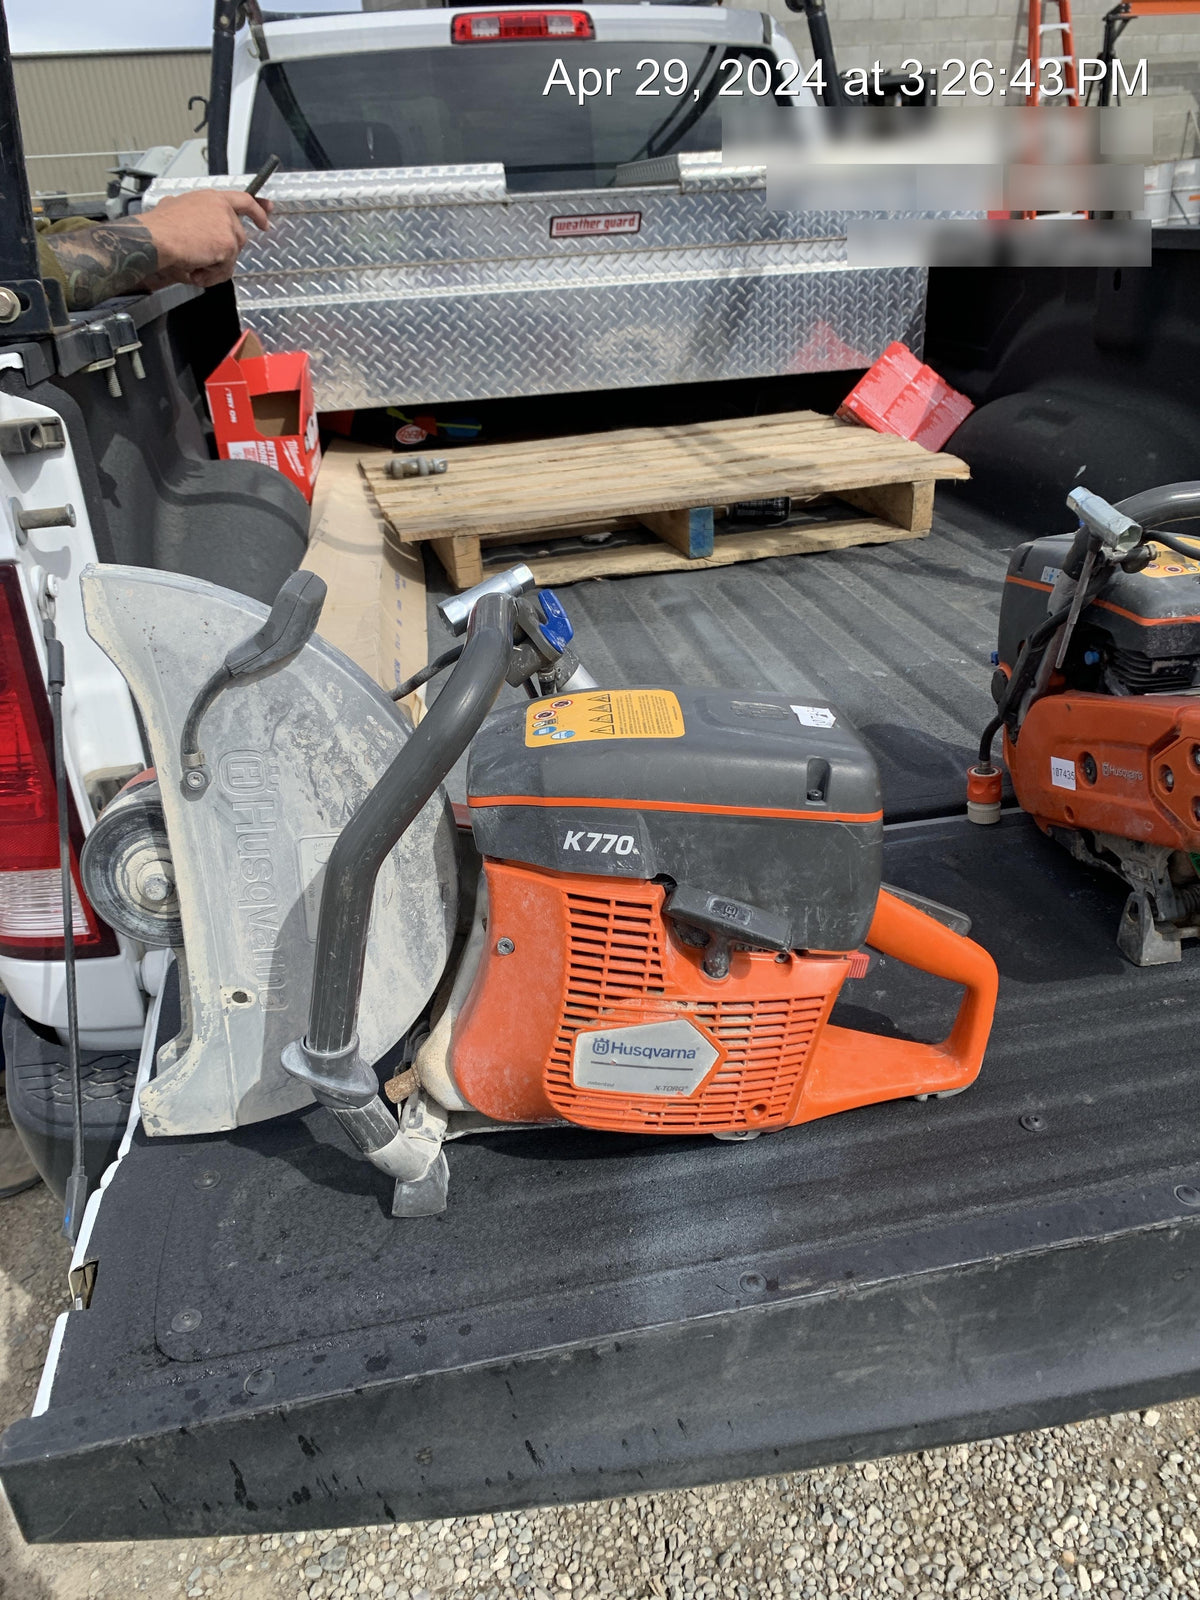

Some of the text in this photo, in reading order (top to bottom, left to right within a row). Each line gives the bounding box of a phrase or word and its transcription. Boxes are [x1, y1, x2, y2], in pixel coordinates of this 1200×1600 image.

[555, 215, 636, 231] weather guard
[232, 801, 290, 1012] Husqvarna
[610, 1041, 697, 1060] Husqvarna
